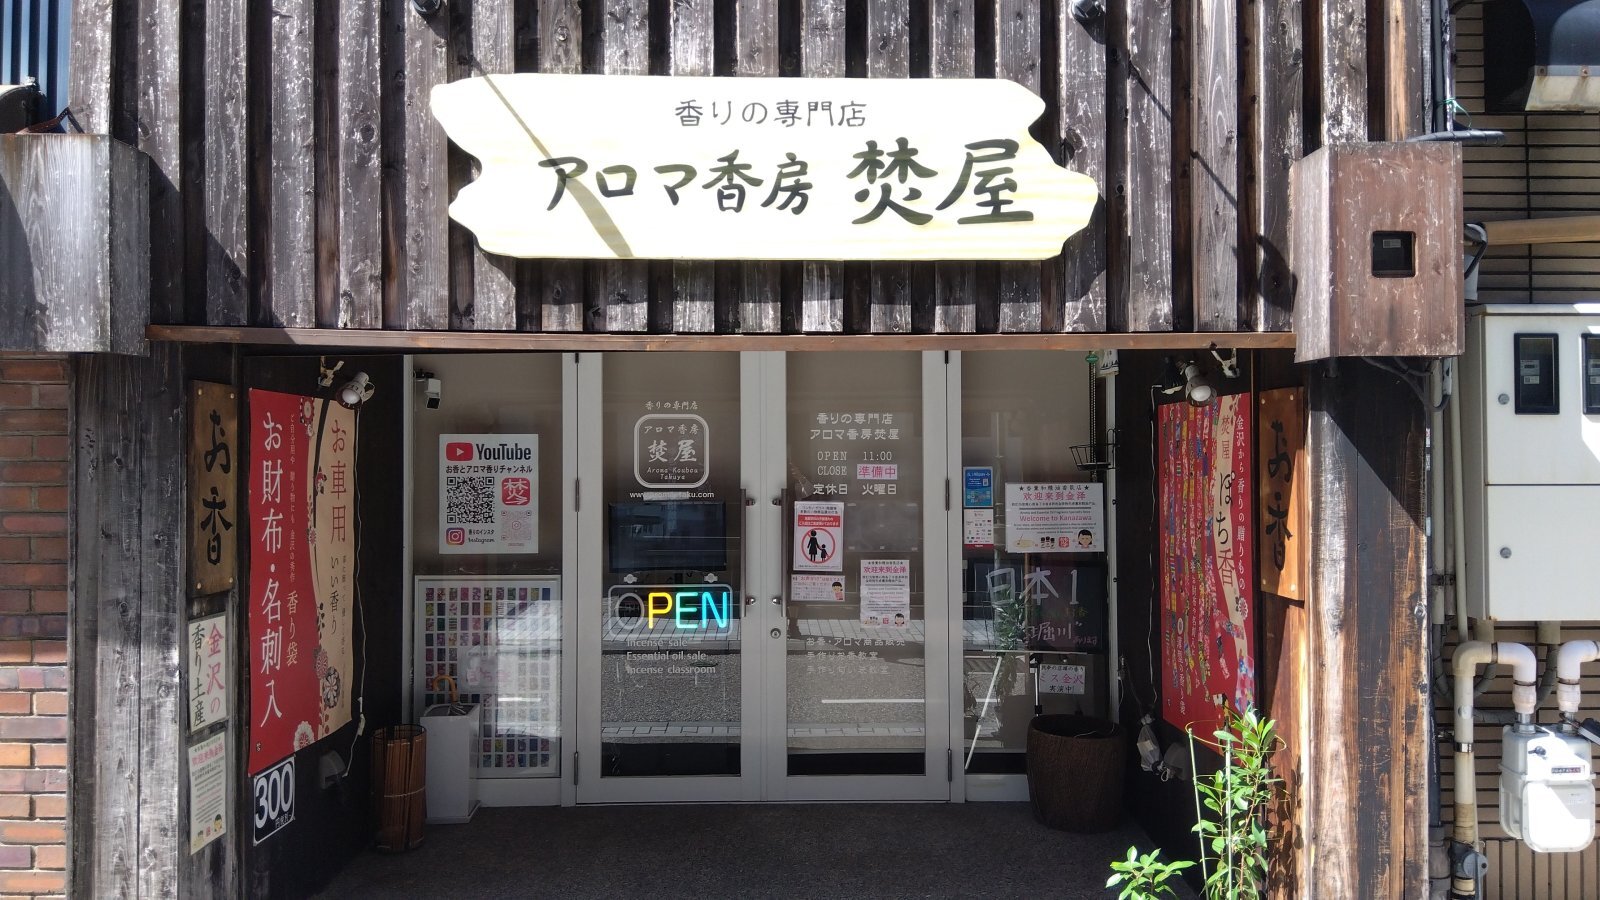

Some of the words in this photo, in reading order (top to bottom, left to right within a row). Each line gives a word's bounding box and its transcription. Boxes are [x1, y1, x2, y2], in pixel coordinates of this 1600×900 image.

[675, 99, 868, 128] 香りの専門店
[538, 149, 814, 216] アロマ香房
[845, 137, 1035, 226] 焚屋
[645, 400, 699, 411] 香りの専門店
[816, 412, 894, 426] 香りの専門店
[643, 423, 700, 436] アロマ香房
[808, 428, 900, 441] アロマ香房焚屋
[475, 443, 532, 461] YouTube
[647, 439, 698, 463] 焚屋
[817, 451, 848, 462] OPEN
[862, 451, 893, 462] 11:00
[446, 464, 533, 475] お香とアロマ香りチャンネル
[646, 466, 669, 474] Aroma
[817, 465, 848, 477] CLOSE
[858, 465, 897, 478] 準備中
[330, 419, 347, 545] お車用
[659, 473, 686, 481] Takuya
[200, 408, 234, 566] お香
[813, 483, 848, 496] 定休日
[861, 483, 898, 496] 火曜日
[1265, 418, 1294, 572] お香
[1059, 514, 1092, 522] Kanazawa
[615, 591, 728, 629] OPEN
[626, 639, 664, 648] Incense
[668, 639, 689, 647] sale
[626, 651, 670, 661] Essential
[671, 651, 684, 661] oil
[686, 651, 708, 661] sale
[206, 622, 226, 714] 金沢の
[626, 665, 664, 674] Incense
[667, 665, 717, 674] classroom
[190, 622, 206, 728] 香り土産
[254, 763, 295, 830] 300
